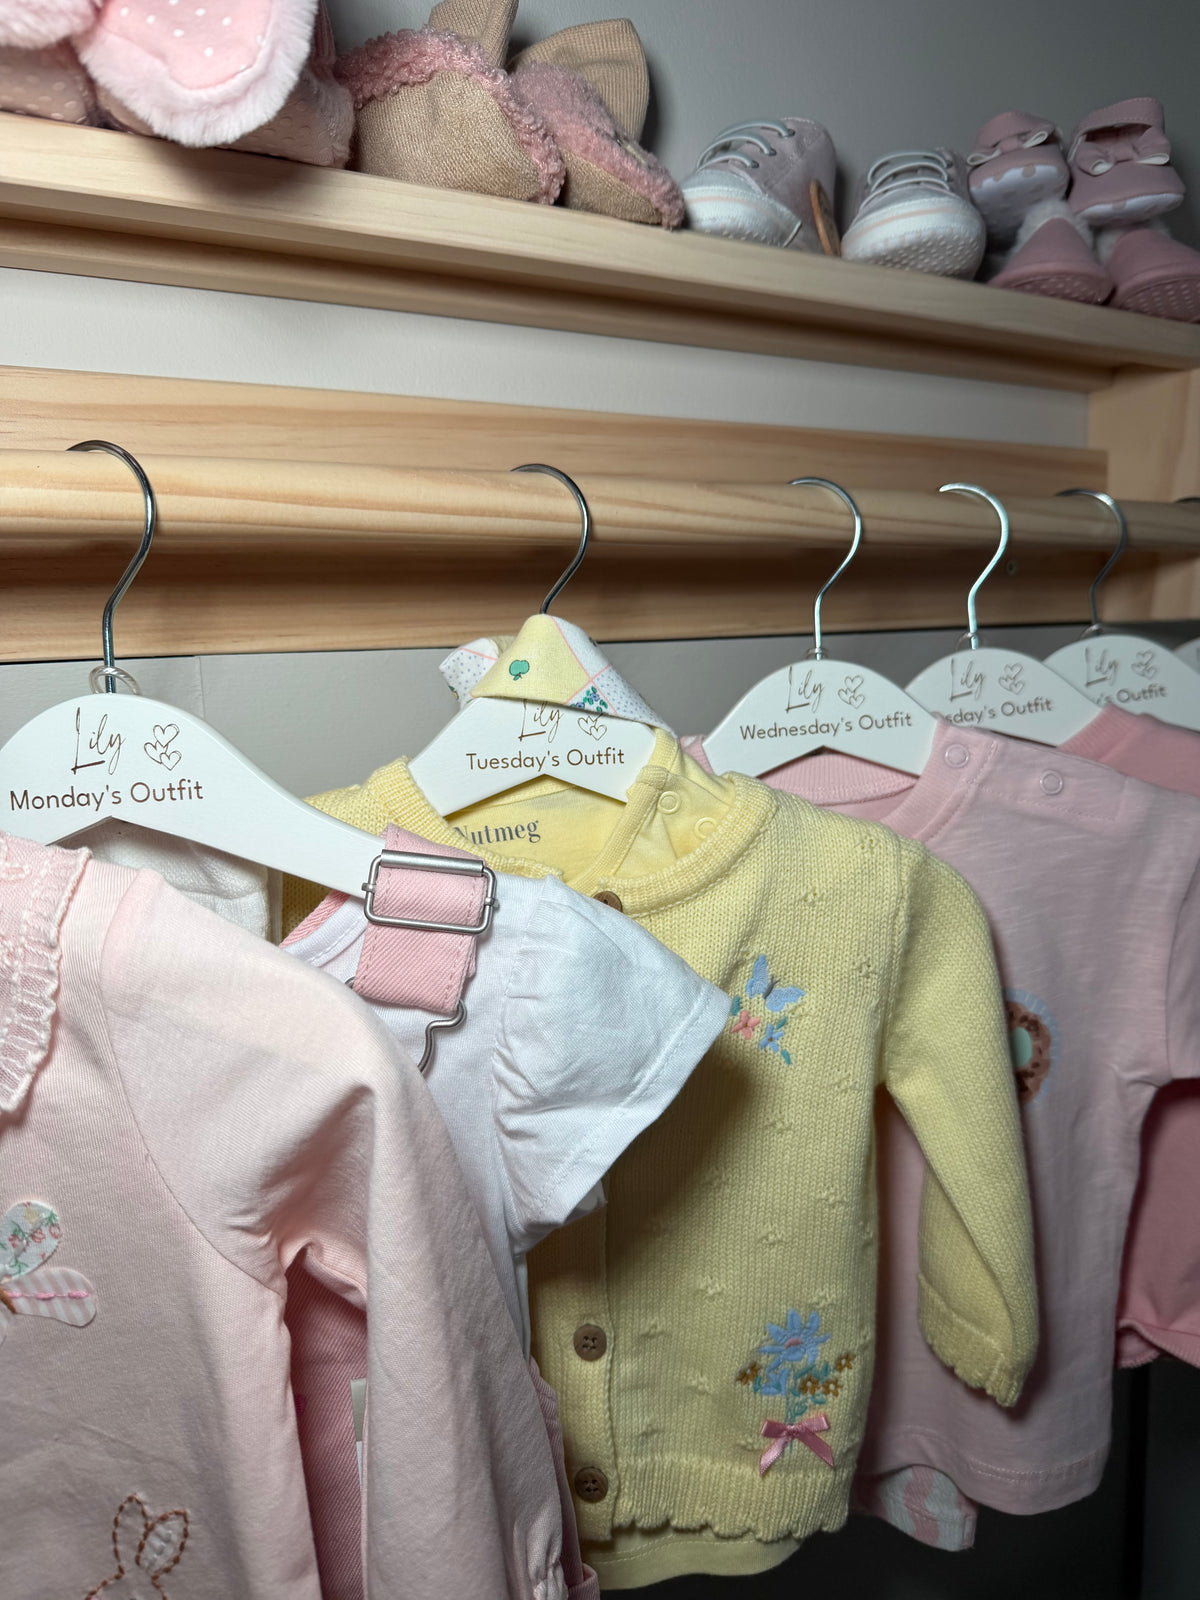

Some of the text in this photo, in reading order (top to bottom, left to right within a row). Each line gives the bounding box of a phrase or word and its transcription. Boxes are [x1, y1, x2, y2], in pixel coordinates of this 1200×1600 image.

[949, 658, 986, 702] Lily
[1084, 647, 1119, 687] Lily
[785, 666, 824, 713] Lily
[1000, 696, 1053, 717] Outfit
[1116, 683, 1168, 703] Outfit
[518, 699, 564, 744] Lily
[739, 711, 912, 741] Wednesday's Outfit
[71, 706, 127, 776] Lily
[466, 746, 625, 772] Tuesday's Outfit
[9, 778, 204, 812] Monday's Outfit
[453, 820, 541, 845] Nutmeg
